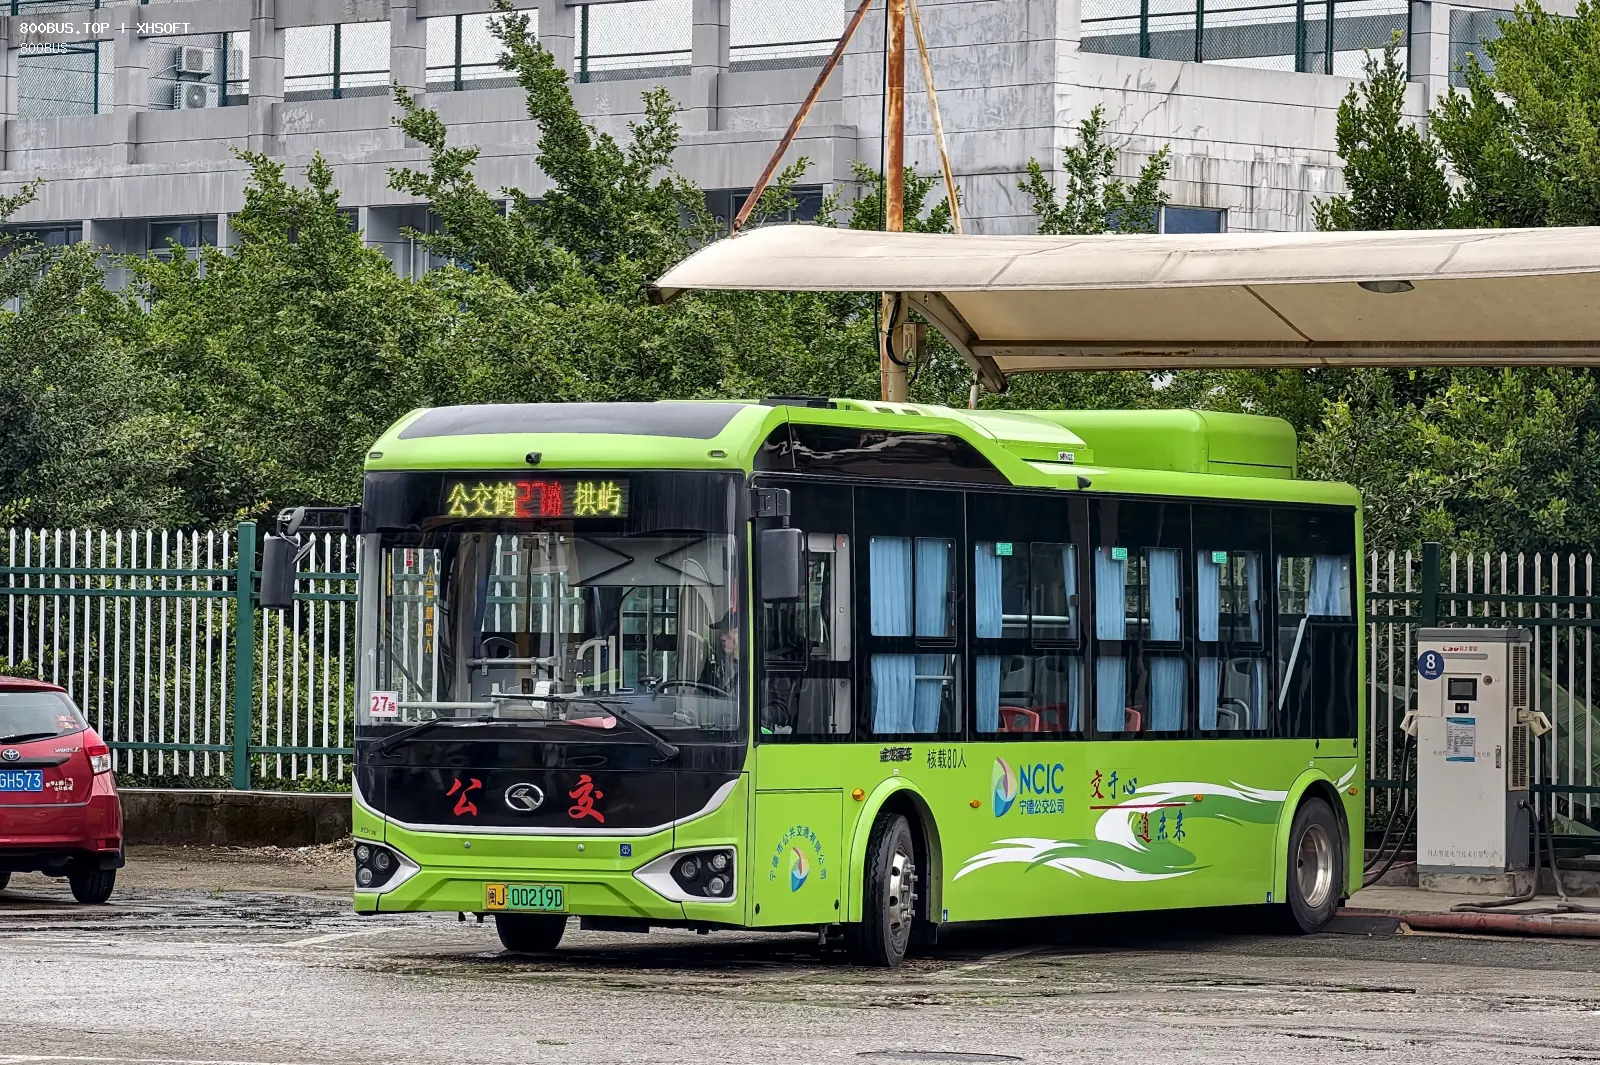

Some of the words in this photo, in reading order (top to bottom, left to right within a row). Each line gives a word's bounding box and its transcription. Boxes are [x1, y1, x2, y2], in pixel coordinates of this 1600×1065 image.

[572, 481, 622, 517] 拱屿
[1426, 653, 1436, 670] 8
[926, 748, 967, 769] 核载80人
[1019, 763, 1065, 795] NCIC
[446, 777, 482, 817] 公
[567, 773, 605, 824] 交
[1019, 798, 1066, 815] 宁德公交公司
